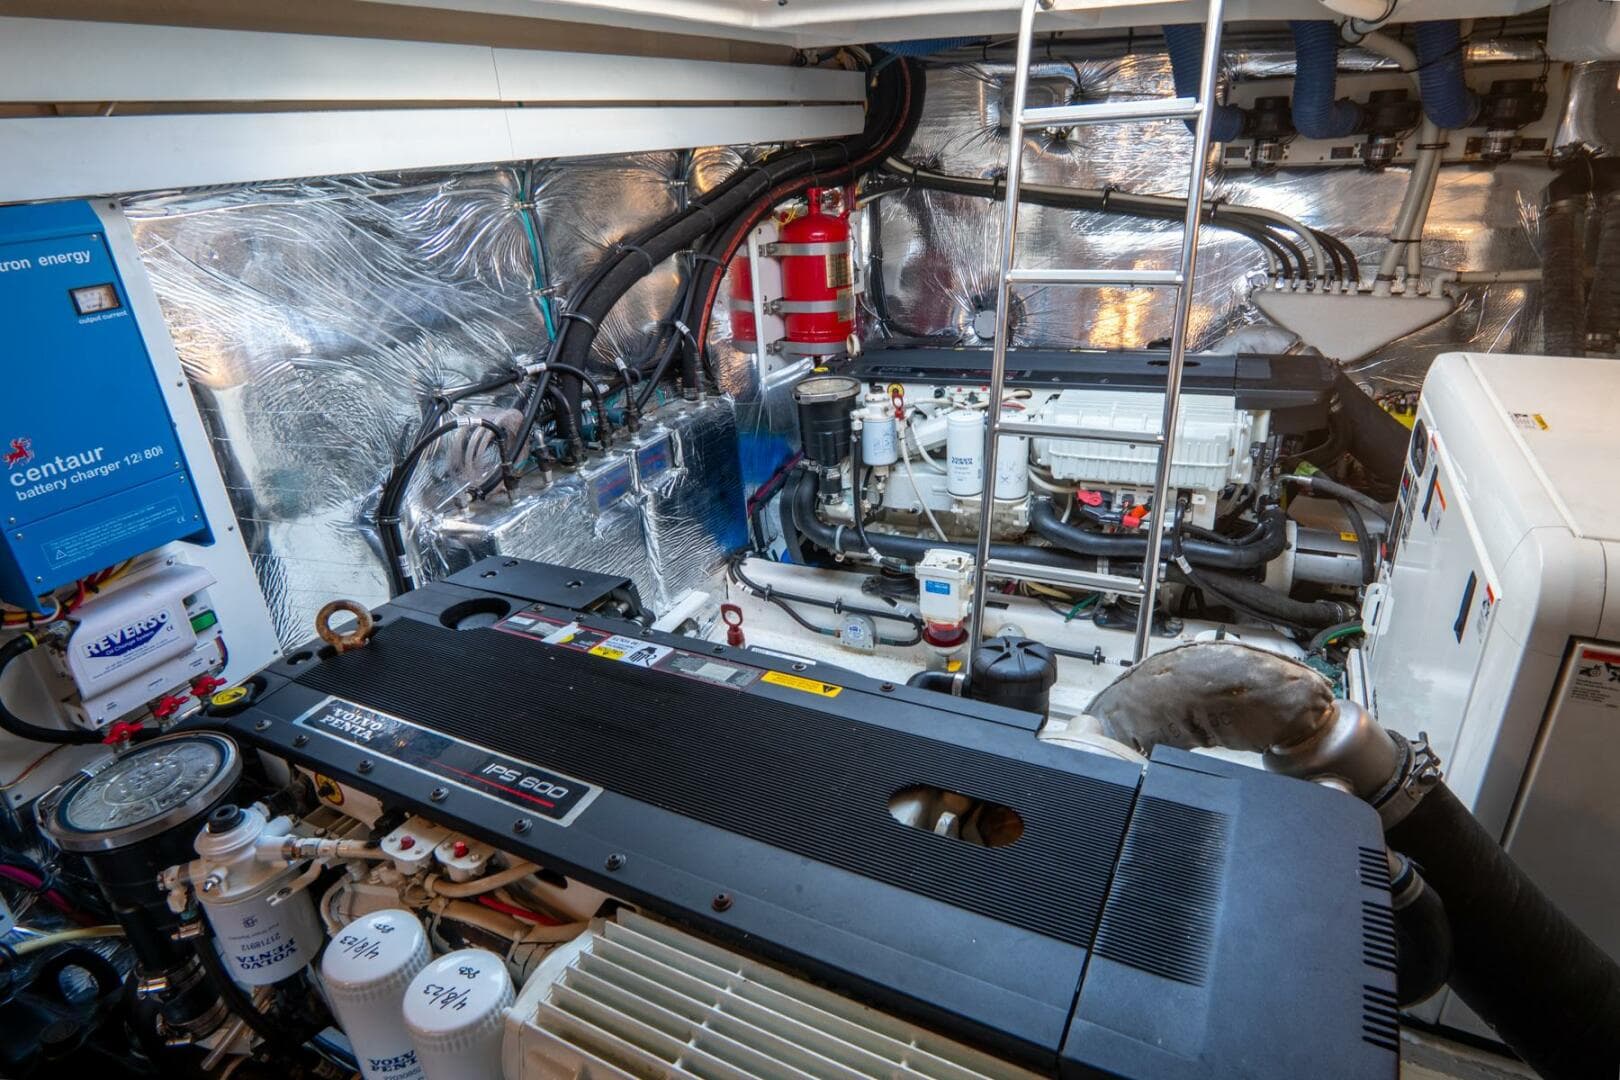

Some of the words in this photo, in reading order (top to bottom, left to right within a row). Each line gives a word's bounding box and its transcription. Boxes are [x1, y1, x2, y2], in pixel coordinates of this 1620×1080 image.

[38, 250, 91, 266] energy
[10, 447, 104, 487] centaur
[16, 477, 68, 501] battery
[70, 460, 121, 484] charger
[82, 609, 169, 657] REVERSO
[320, 715, 373, 740] PENTA
[333, 708, 382, 730] VOLVO
[482, 763, 522, 782] IPS
[519, 776, 569, 798] 600
[236, 937, 295, 962] PENTA
[241, 947, 297, 970] VOLVO
[340, 935, 381, 960] 4/8/23
[423, 984, 471, 1011] 4/8/23
[368, 1050, 415, 1066] VOLV
[371, 1056, 417, 1072] PENT
